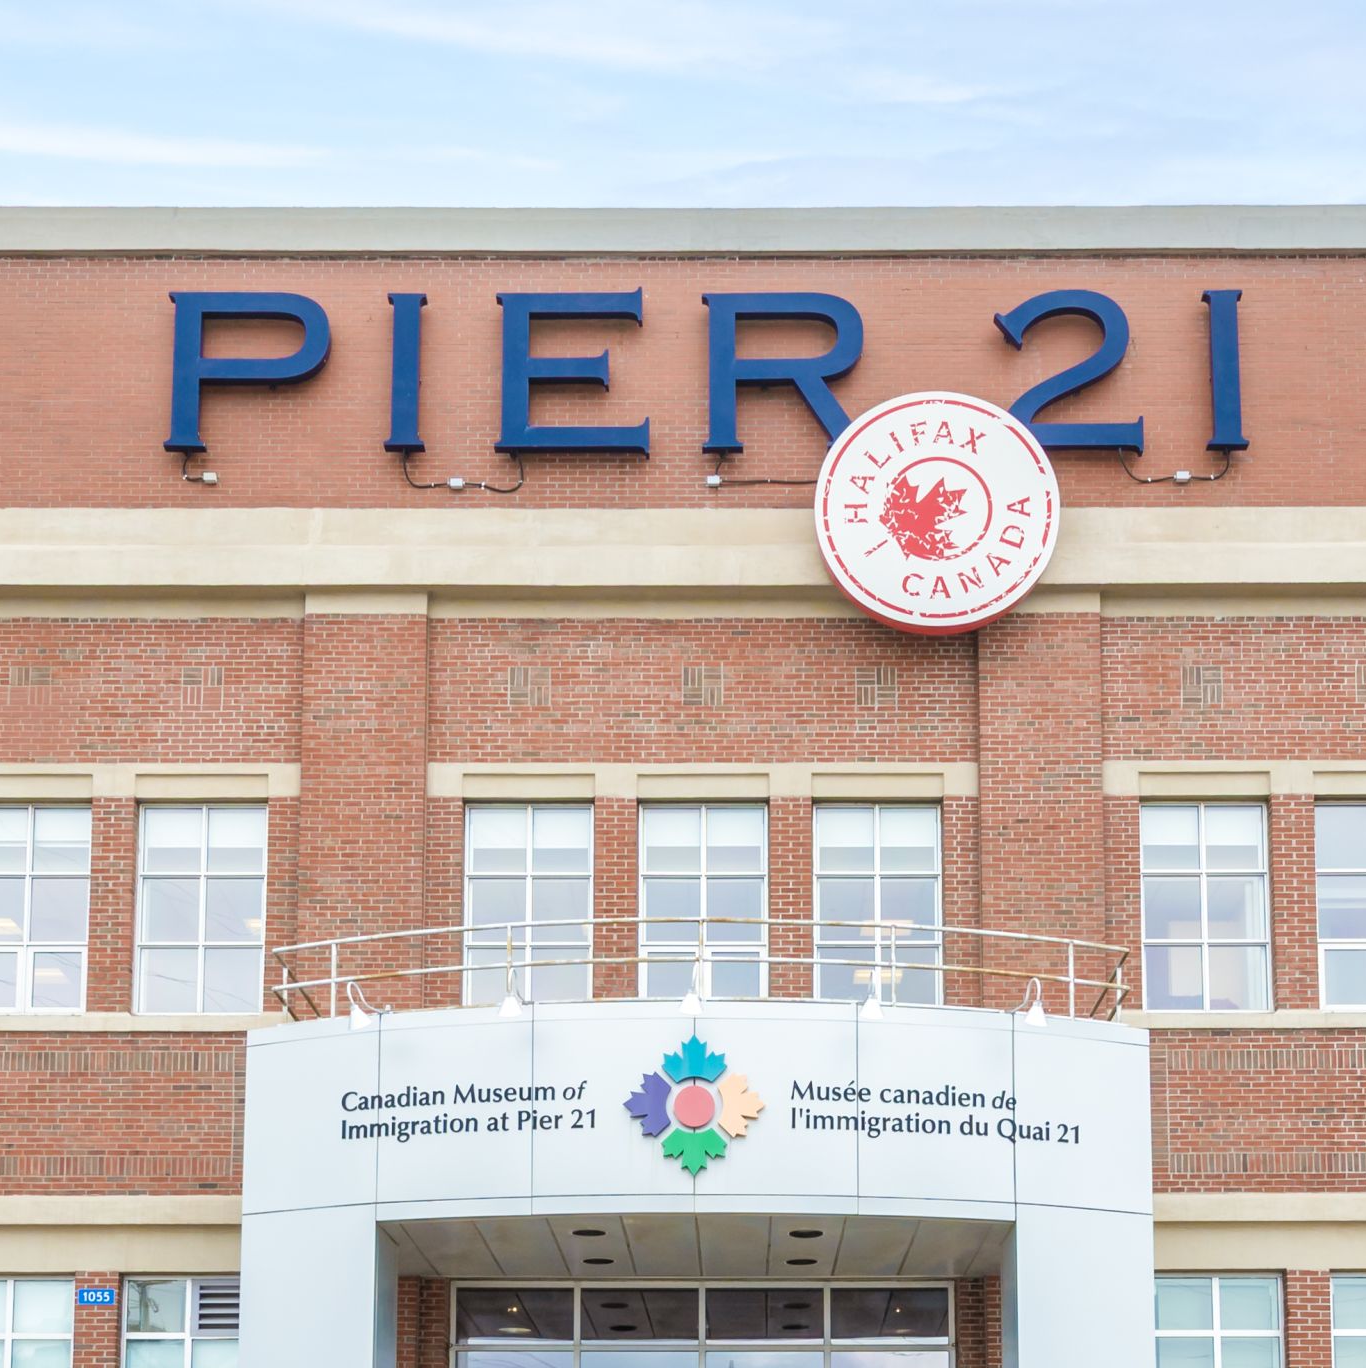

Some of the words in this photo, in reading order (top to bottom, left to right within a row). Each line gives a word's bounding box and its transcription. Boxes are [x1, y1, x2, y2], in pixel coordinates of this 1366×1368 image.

[162, 287, 865, 460] PIER
[992, 288, 1249, 456] 21
[843, 420, 987, 524] HALIFAX
[901, 496, 1032, 599] CANADA
[341, 1086, 445, 1112] Canadian
[453, 1083, 556, 1104] Museum
[562, 1080, 588, 1100] of
[790, 1080, 871, 1102] Musée
[879, 1085, 986, 1108] canadien
[991, 1090, 1017, 1111] de
[341, 1113, 479, 1143] Immigration
[486, 1112, 509, 1132] at
[517, 1109, 563, 1130] Pier
[570, 1108, 596, 1129] 21
[791, 1107, 951, 1138] l'immigration
[959, 1114, 989, 1136] du
[996, 1118, 1051, 1144] Quai
[1056, 1123, 1081, 1144] 21
[83, 1291, 111, 1302] 1055
